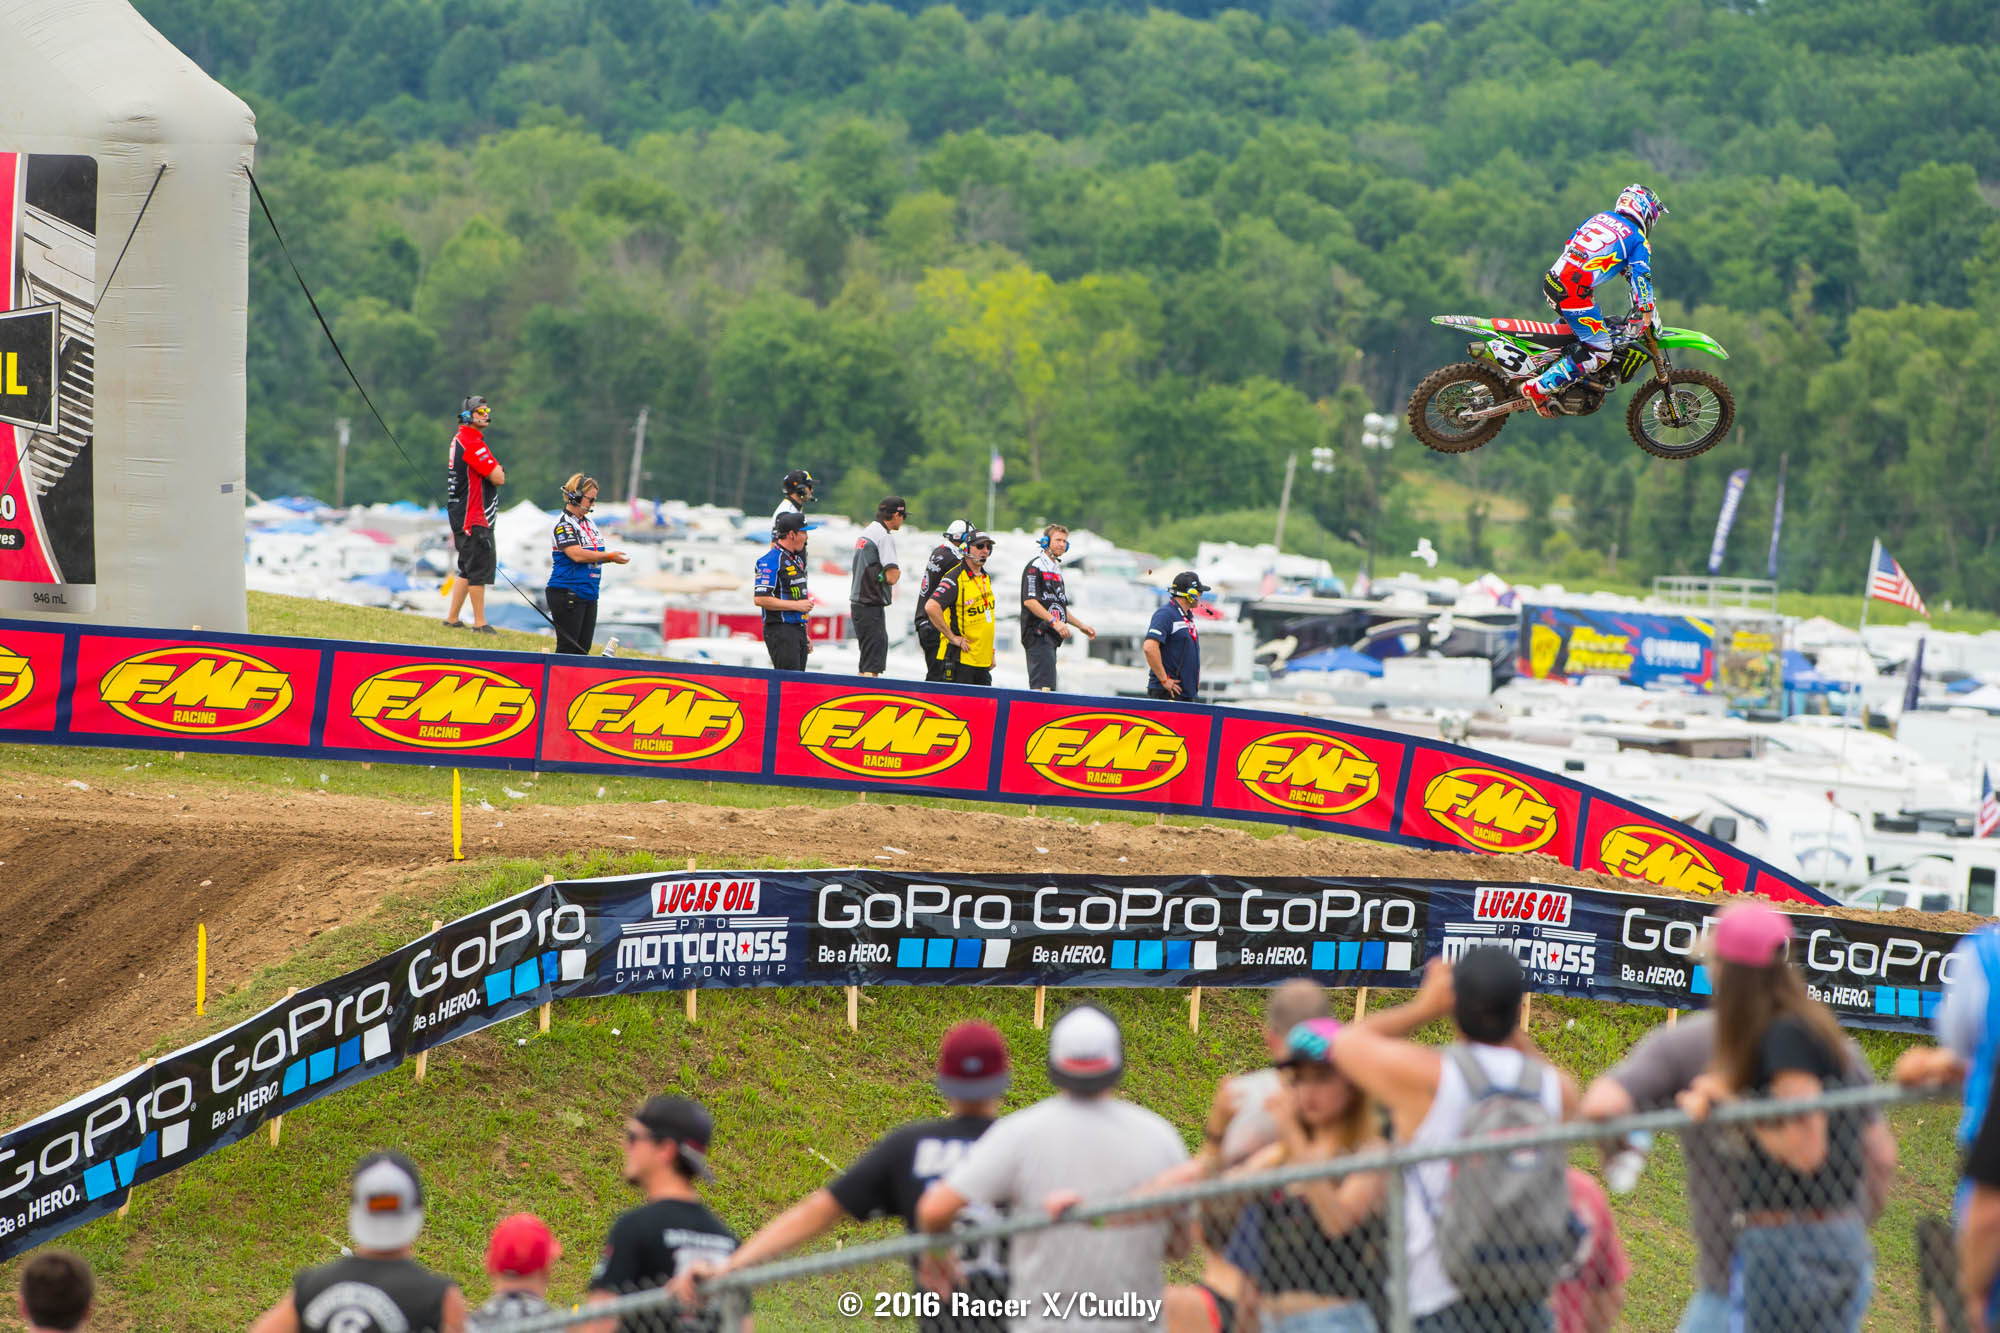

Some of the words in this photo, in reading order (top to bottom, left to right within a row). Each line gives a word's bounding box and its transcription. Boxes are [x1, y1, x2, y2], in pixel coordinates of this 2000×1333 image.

[1573, 221, 1618, 252] 3
[0, 352, 28, 395] L
[1496, 345, 1528, 373] 3
[0, 534, 15, 545] es
[100, 658, 291, 710] FMF
[350, 675, 534, 725] FMF
[173, 710, 216, 724] RACING
[568, 688, 740, 738] FMF
[419, 725, 460, 739] RACING
[633, 738, 673, 752] RACING
[799, 705, 968, 755] FMF
[863, 754, 901, 769] RACING
[1025, 723, 1186, 771] FMF
[1087, 771, 1121, 785] RACING
[1236, 743, 1379, 793] FMF
[1289, 789, 1325, 805] RACING
[1424, 775, 1557, 835] FMF
[1473, 826, 1502, 844] RACING
[1600, 830, 1725, 896] FMF
[657, 882, 721, 914] LUCAS
[723, 882, 755, 911] OIL
[817, 884, 1011, 929] GoPro
[1033, 887, 1221, 932] GoPro
[1239, 889, 1415, 933] GoPro
[1478, 890, 1537, 920] LUCAS
[1538, 893, 1567, 922] OIL
[680, 918, 726, 930] PRO
[1498, 924, 1541, 937] PRO
[408, 904, 586, 998] GoPro
[616, 931, 788, 969] MOTOCROSS
[818, 946, 835, 963] Be
[837, 950, 846, 963] a
[849, 944, 891, 963] HERO.
[1032, 946, 1049, 963] Be
[1051, 951, 1059, 963] a
[1061, 944, 1106, 964] HERO.
[1241, 948, 1256, 965] Be
[1256, 952, 1263, 965] a
[1264, 946, 1307, 965] HERO.
[1621, 964, 1635, 982] Be
[1637, 971, 1644, 982] a
[1645, 966, 1687, 987] HERO.
[412, 1014, 426, 1033] Be
[429, 1013, 436, 1026] a
[438, 988, 481, 1022] HERO.
[1823, 991, 1830, 1003] a
[1832, 987, 1871, 1007] HERO.
[212, 981, 390, 1094] GoPro
[211, 1111, 226, 1130] Be
[227, 1107, 235, 1120] a
[236, 1081, 279, 1116] HERO.
[17, 1213, 26, 1227] a
[28, 1184, 81, 1223] HERO.
